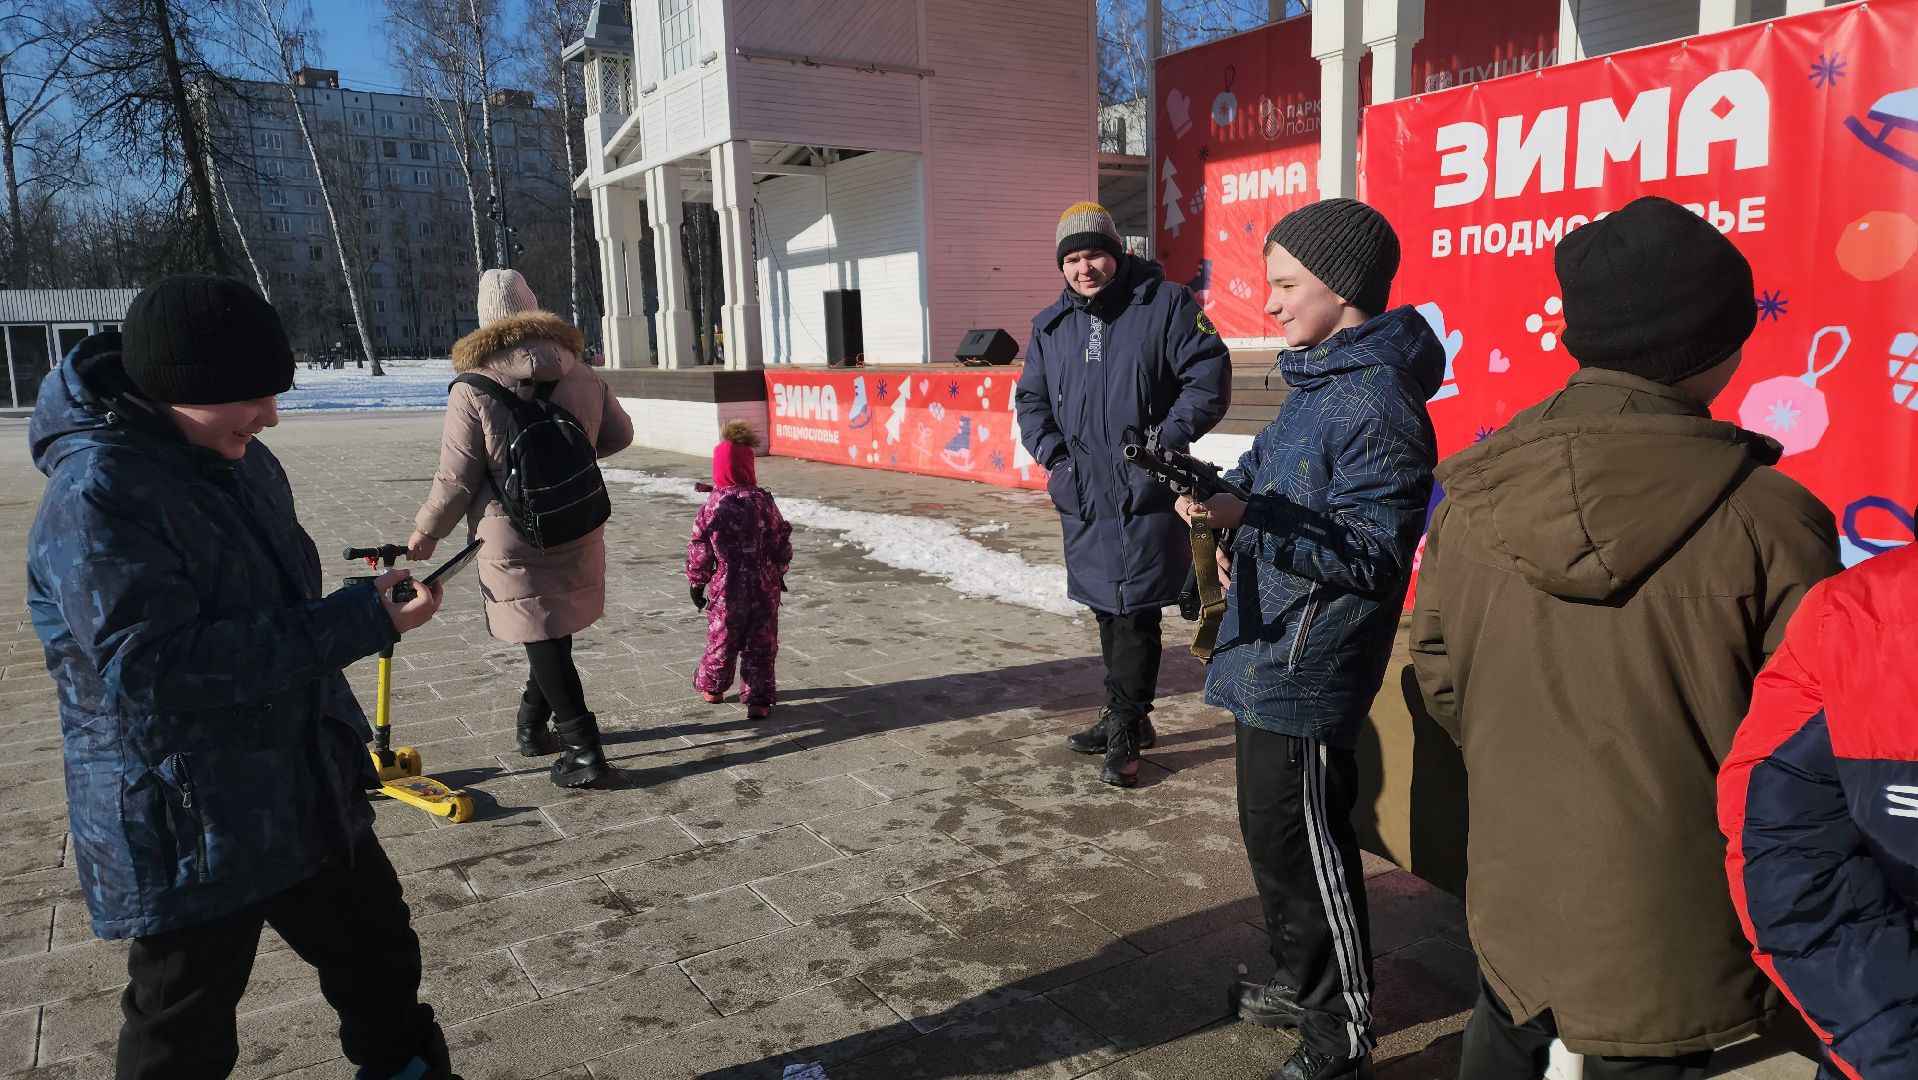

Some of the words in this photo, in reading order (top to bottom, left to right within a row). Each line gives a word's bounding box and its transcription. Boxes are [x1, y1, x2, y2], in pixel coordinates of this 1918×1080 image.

[1433, 68, 1770, 209] ЗИМА
[1221, 161, 1307, 205] ЗИМА
[1431, 228, 1451, 259] В
[1459, 196, 1767, 257] ПОДМОЬЕ
[773, 383, 839, 422] ЗИМА
[776, 423, 783, 437] В
[782, 424, 840, 445] ПОДМОСКОВЬЕ
